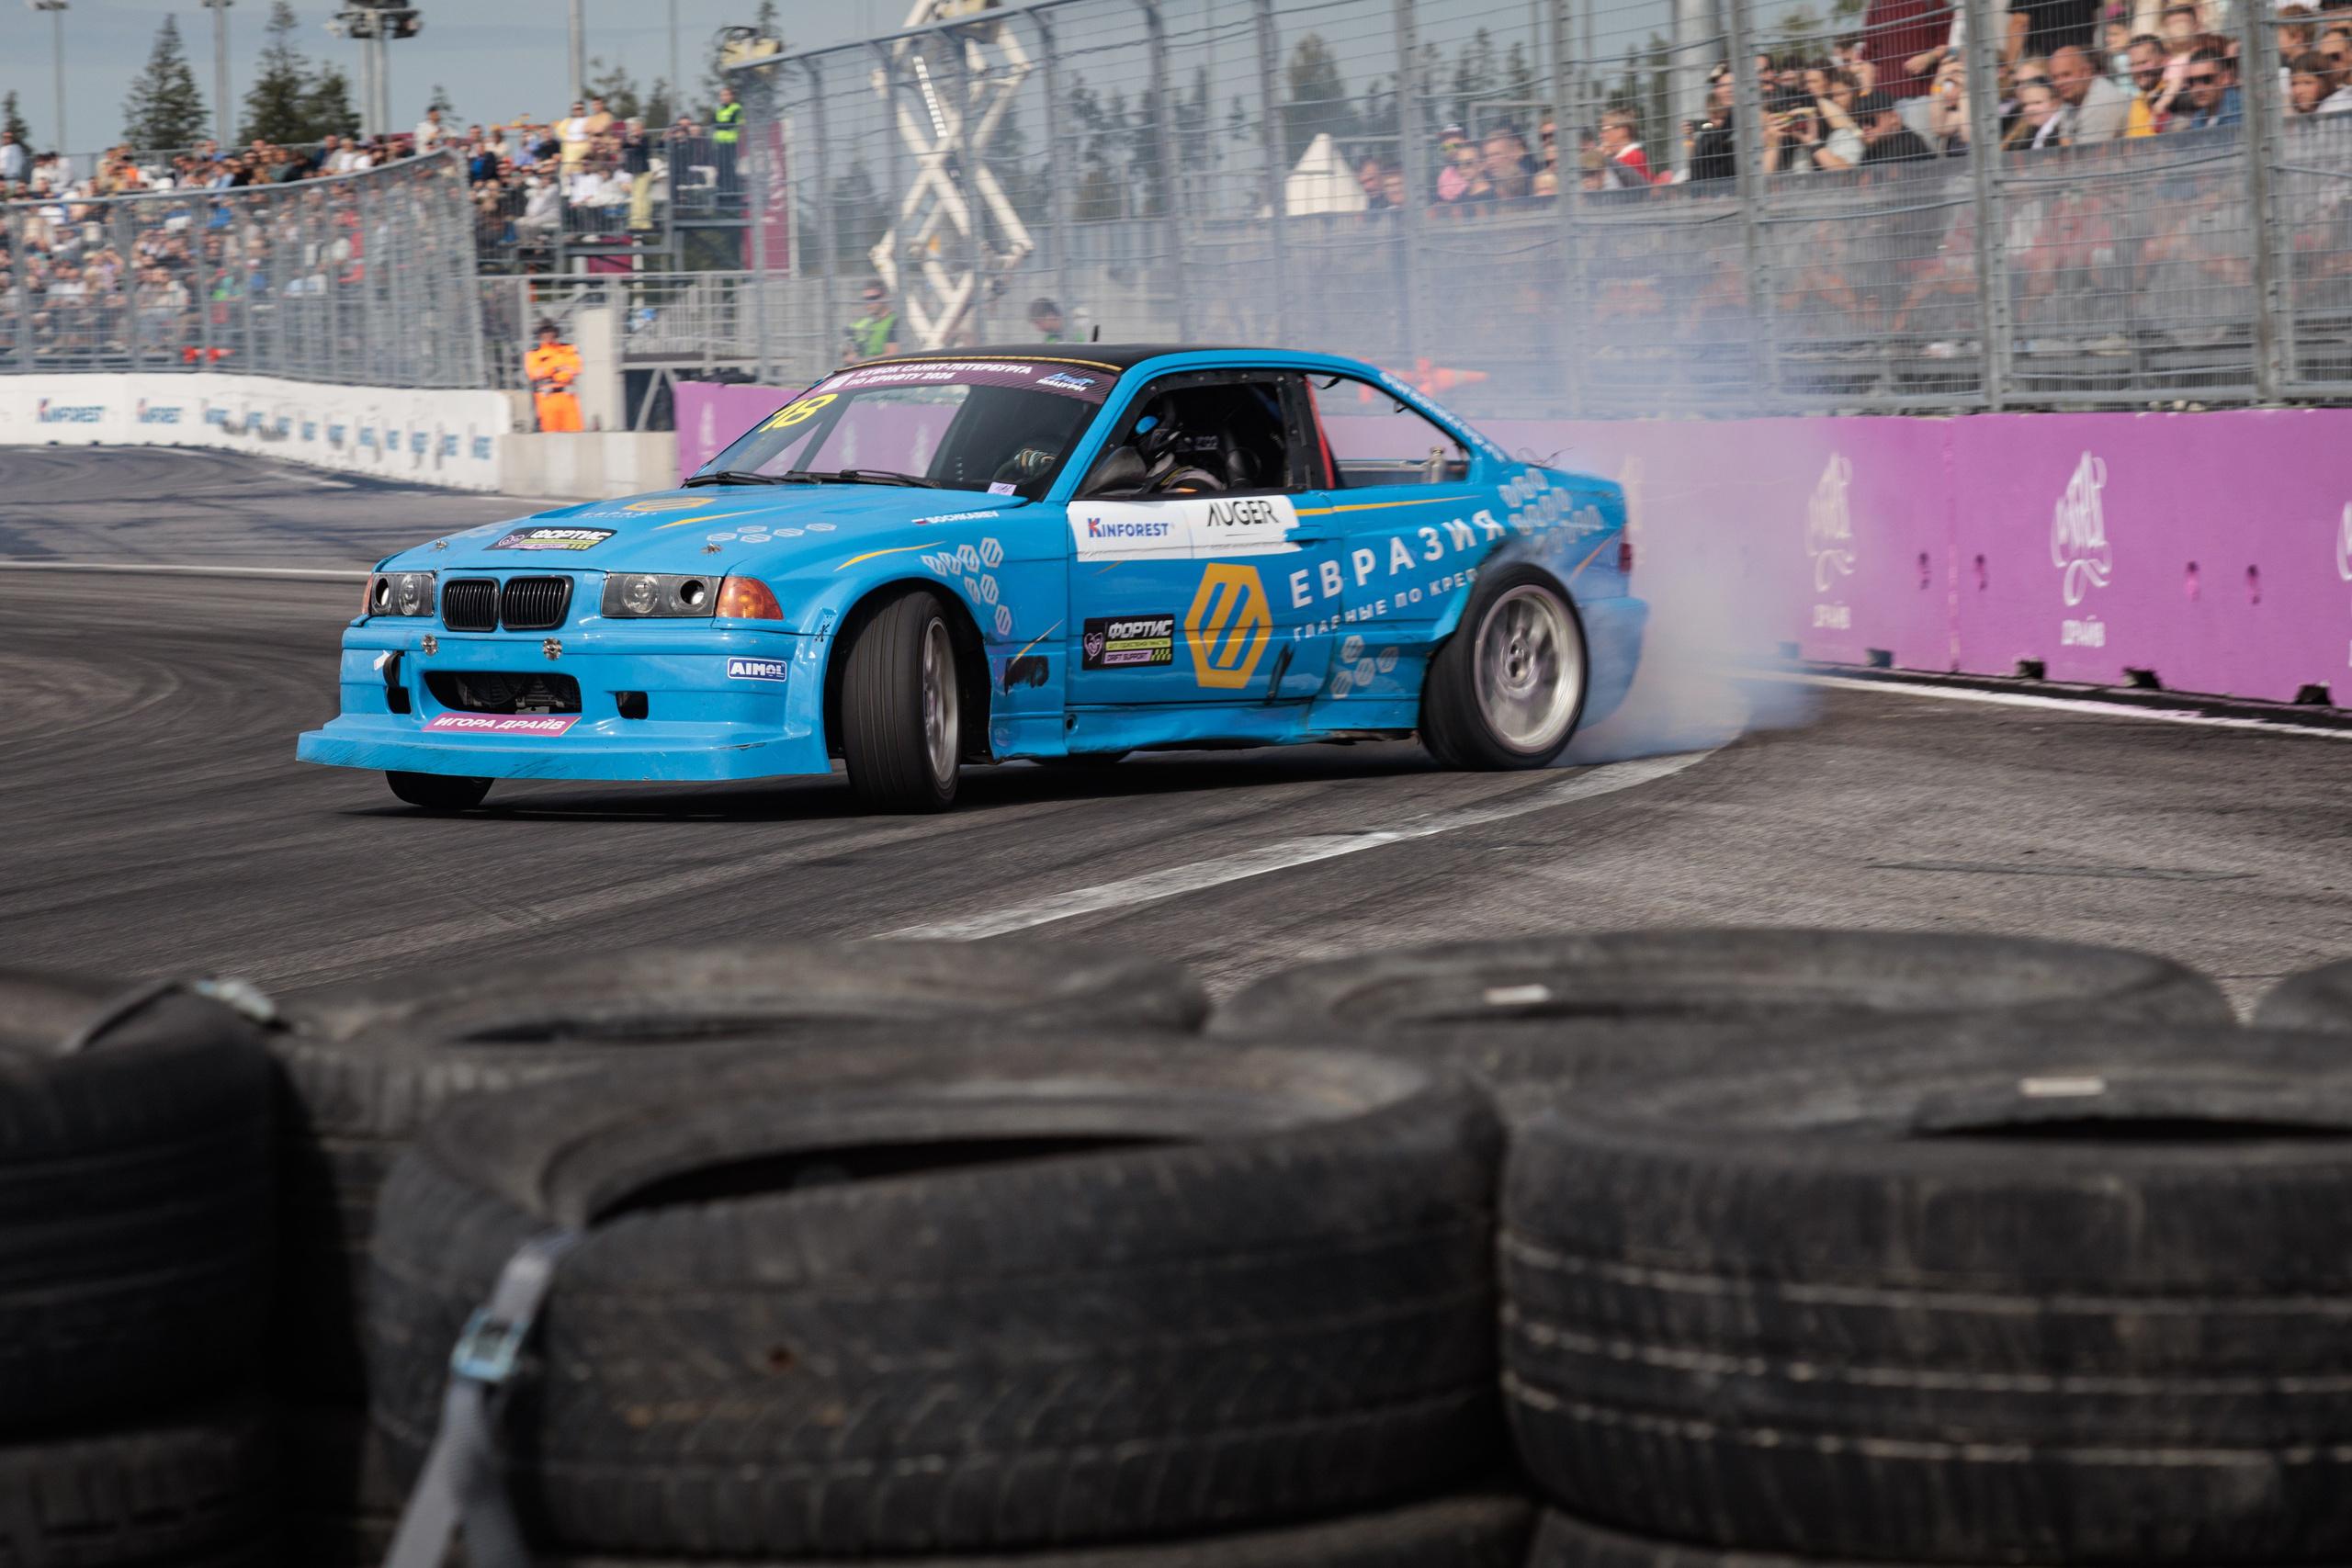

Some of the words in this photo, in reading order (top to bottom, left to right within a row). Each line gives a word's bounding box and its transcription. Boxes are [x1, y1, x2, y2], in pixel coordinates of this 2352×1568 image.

[844, 378, 866, 387] ПО
[864, 373, 924, 384] ДРИФТУ
[855, 366, 904, 378] КУБОК
[901, 363, 1033, 375] САНКТ-ПЕТЕРБУРГА
[757, 393, 839, 434] 18
[1207, 500, 1280, 527] AUGER
[531, 529, 613, 541] ФОРТИС
[1087, 517, 1169, 538] KINFOREST
[1289, 509, 1507, 609] ЕВРАЗИЯ
[1395, 587, 1423, 609] ПО
[1108, 619, 1174, 639] ФОРТИС
[729, 661, 785, 678] AIMOL
[434, 717, 497, 728] ИГОРА
[494, 718, 567, 730] ДРАЙВ
